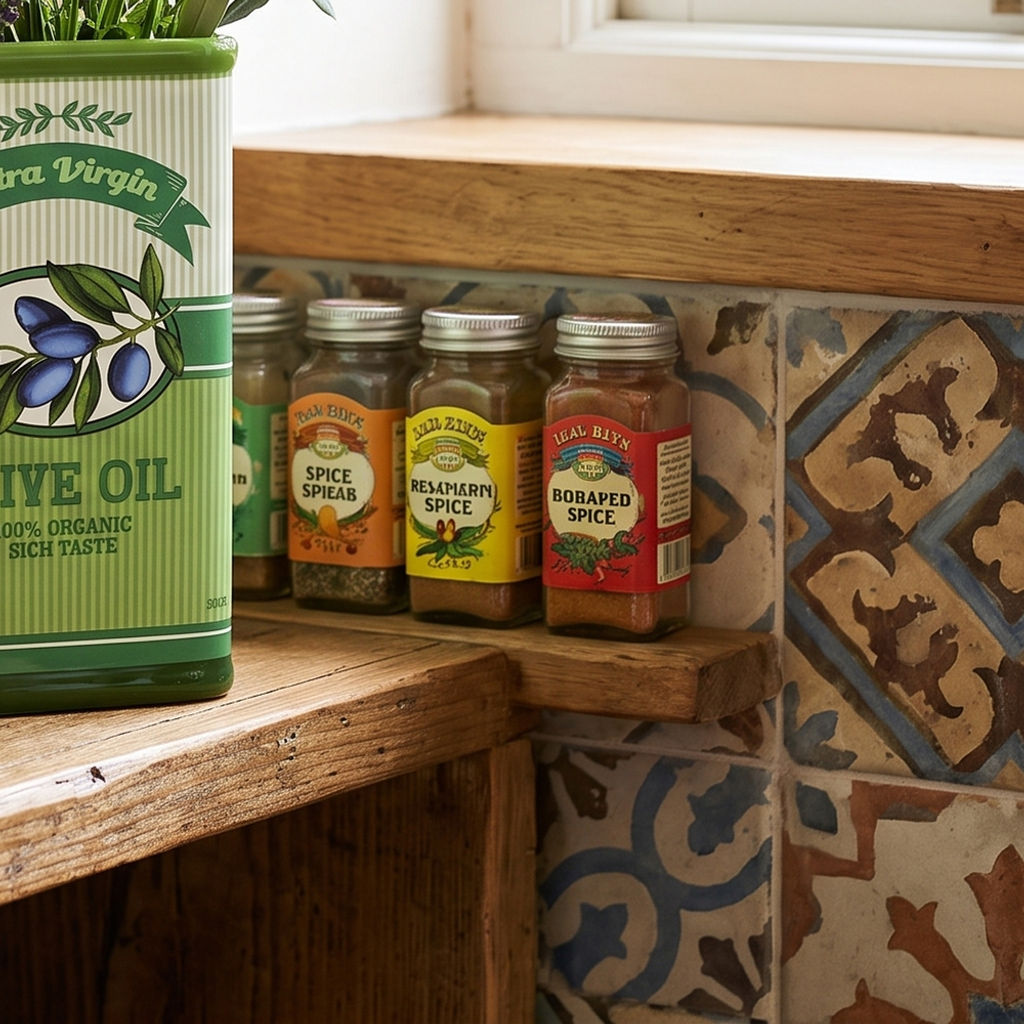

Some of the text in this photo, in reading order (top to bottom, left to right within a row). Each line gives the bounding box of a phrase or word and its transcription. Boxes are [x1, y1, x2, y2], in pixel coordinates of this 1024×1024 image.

[52, 156, 158, 202] Virgin
[99, 457, 182, 504] OIL
[306, 465, 353, 485] SPICE
[302, 483, 358, 502] SPIEAB
[424, 497, 474, 516] SPICE
[567, 507, 617, 526] SPICE
[47, 515, 133, 536] ORGANIC
[8, 536, 119, 560] SICH TASTE
